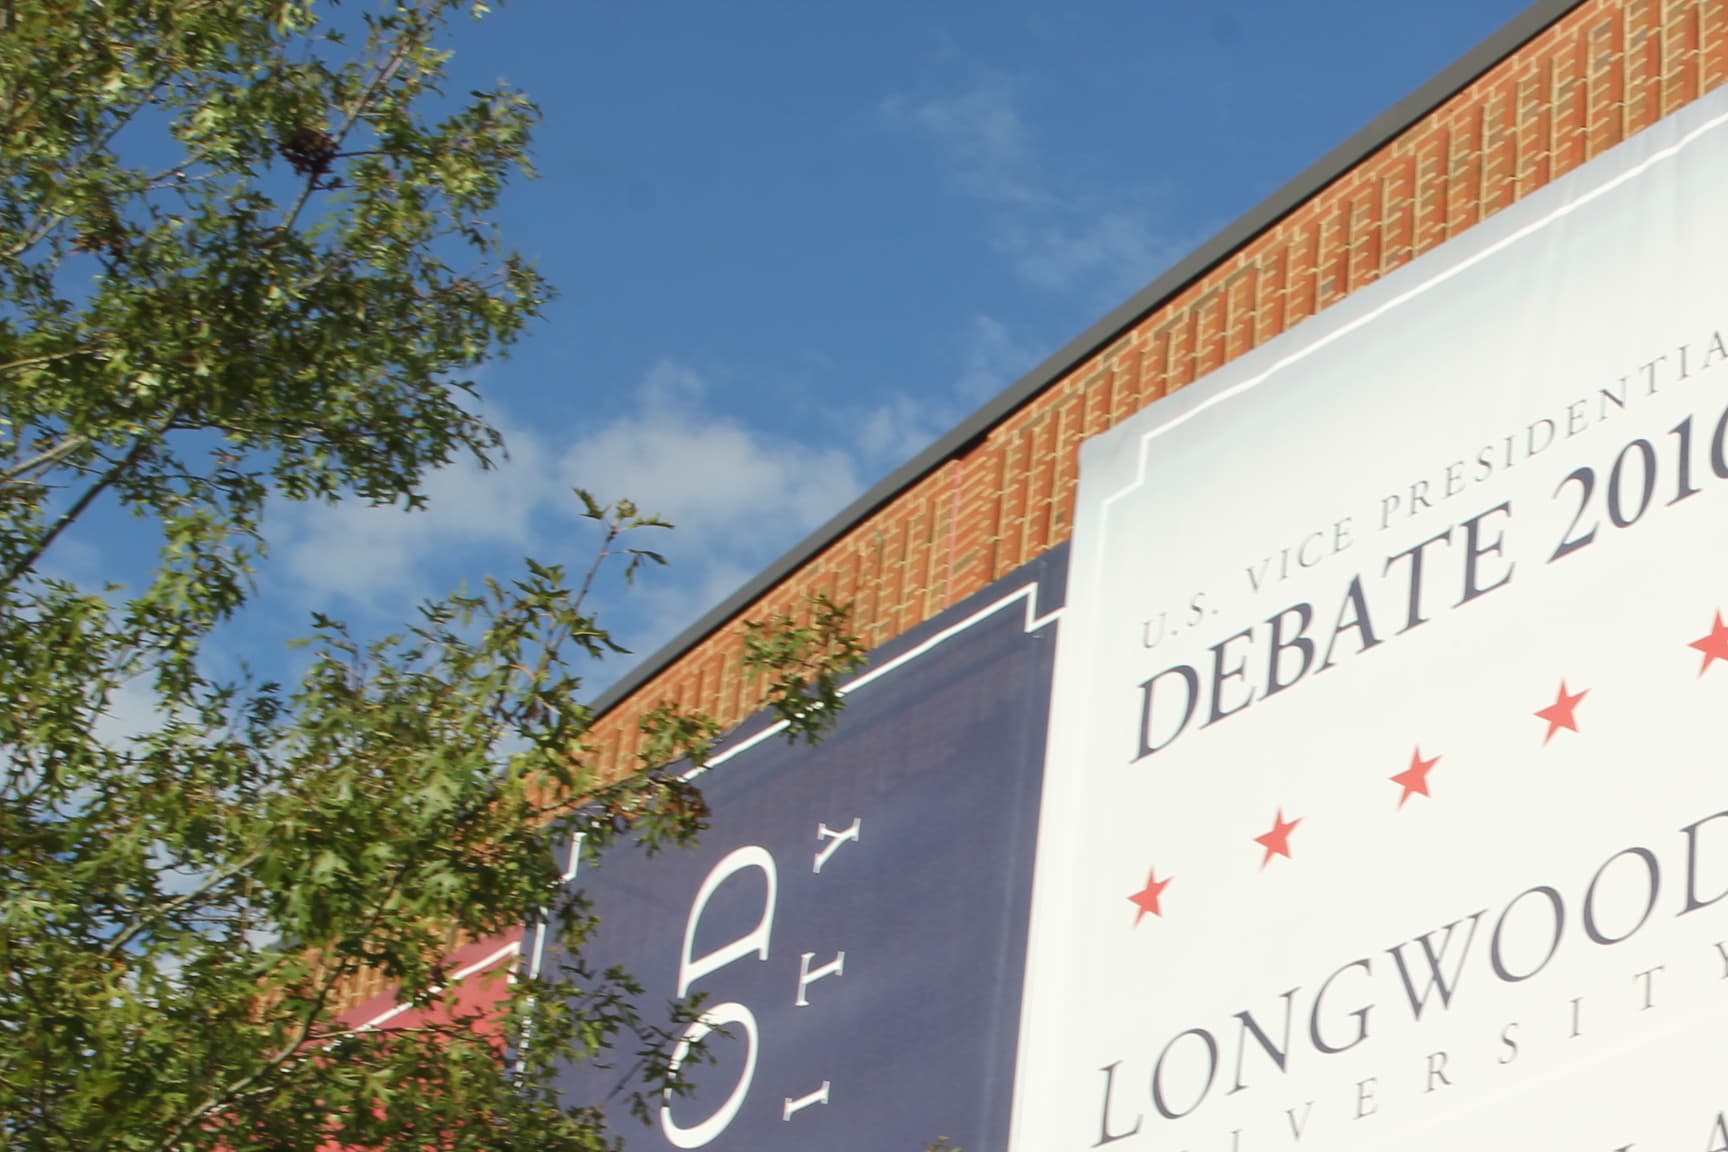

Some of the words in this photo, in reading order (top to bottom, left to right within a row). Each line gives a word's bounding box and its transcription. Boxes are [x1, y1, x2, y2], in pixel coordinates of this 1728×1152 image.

[1129, 501, 1517, 764] DEBATE
[1141, 591, 1219, 650] U.S.
[1243, 516, 1355, 594] VICE
